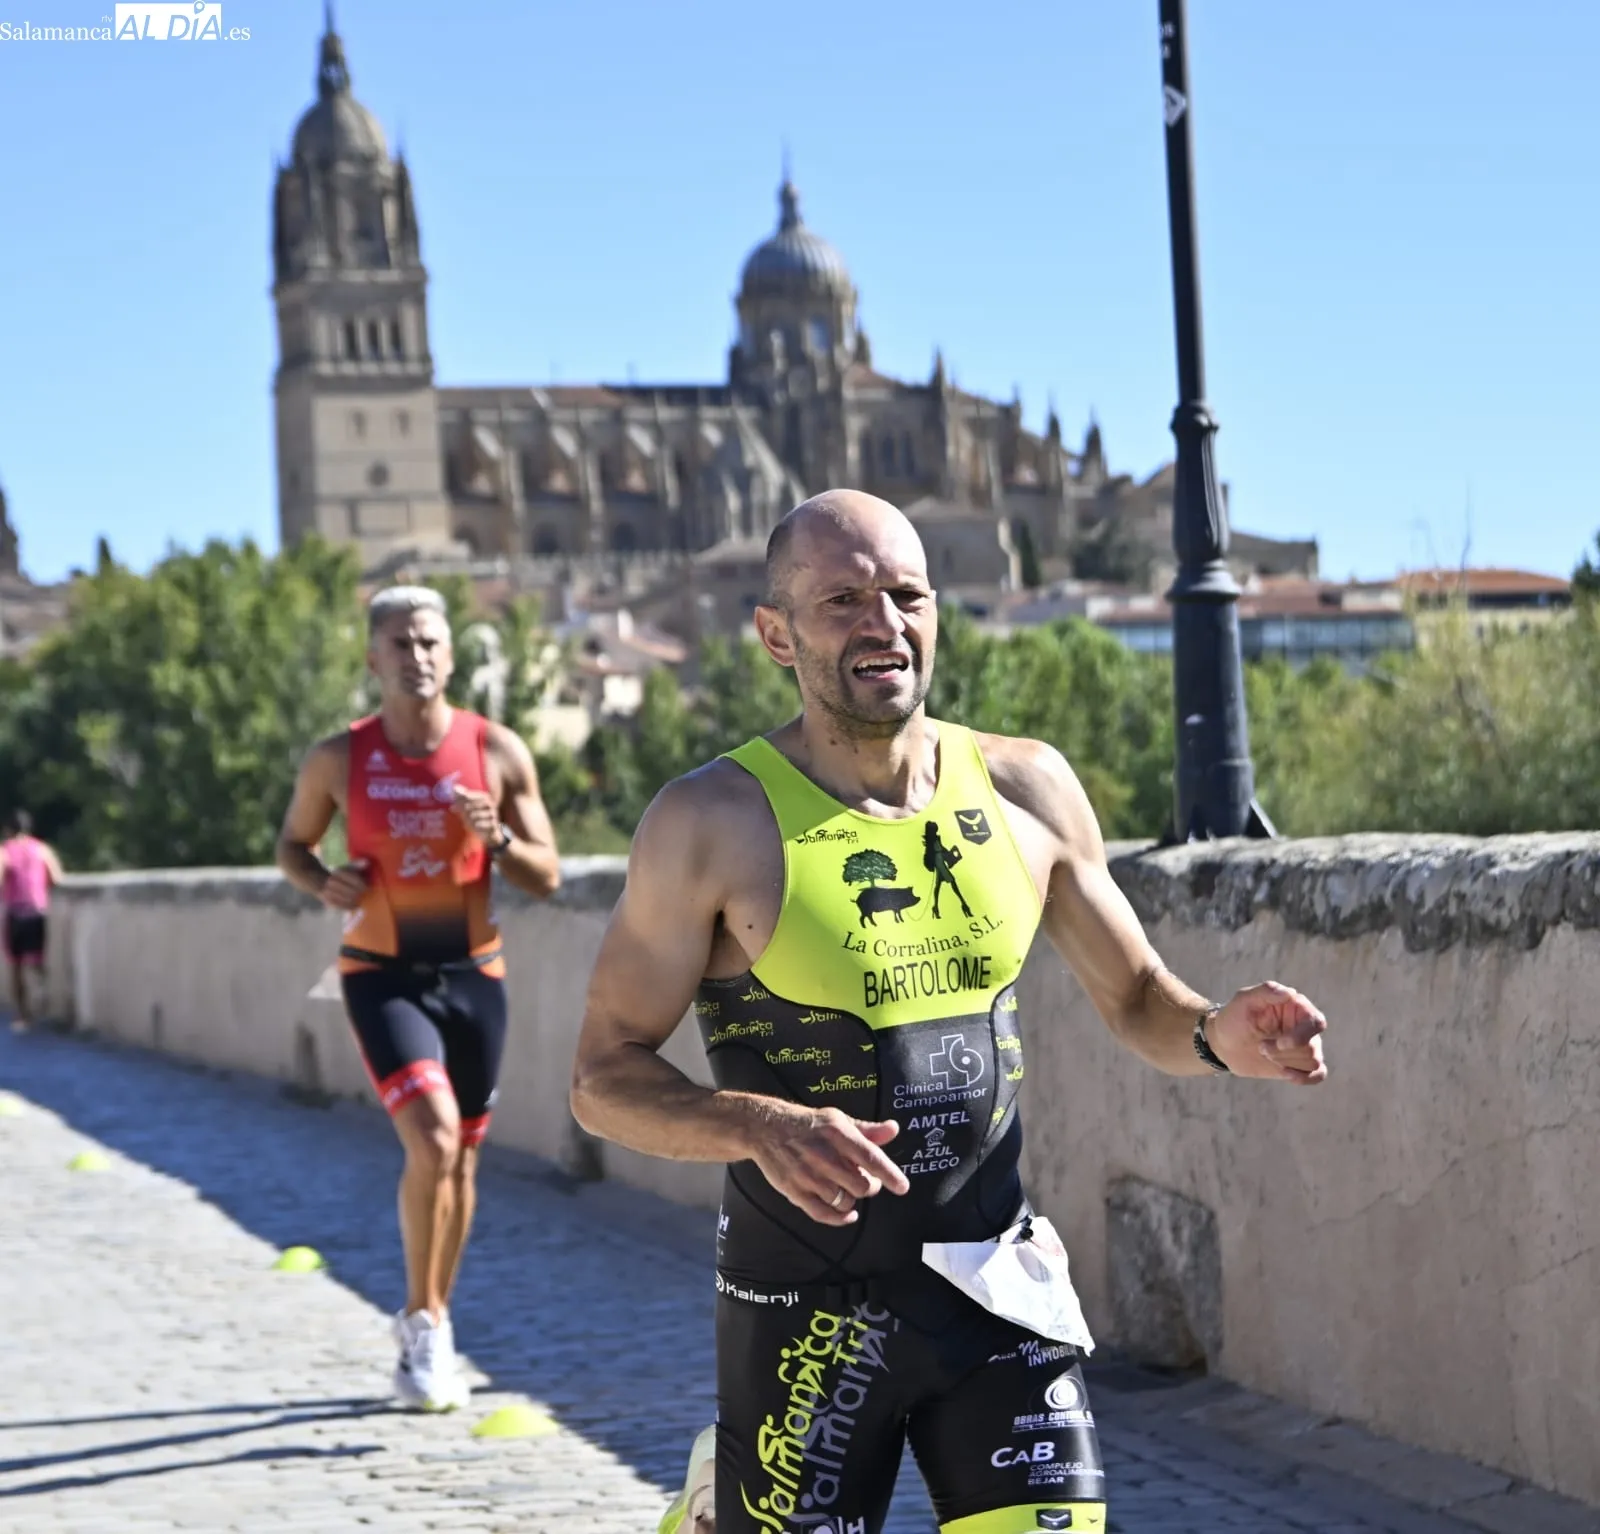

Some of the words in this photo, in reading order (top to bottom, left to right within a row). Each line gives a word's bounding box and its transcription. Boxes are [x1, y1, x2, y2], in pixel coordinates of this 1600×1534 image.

[842, 931, 867, 954] La
[874, 934, 969, 957] Corralina,
[969, 914, 1004, 940] S.L.
[864, 956, 992, 1008] BARTOLOME
[893, 1087, 988, 1109] Campoamor
[907, 1111, 970, 1130] AMTEL
[912, 1146, 953, 1160] AZUL
[900, 1156, 960, 1175] TELECO
[1013, 1413, 1045, 1426] OBRAS
[1030, 1461, 1084, 1471] COMPLEJO
[1027, 1476, 1065, 1486] BEJAR
